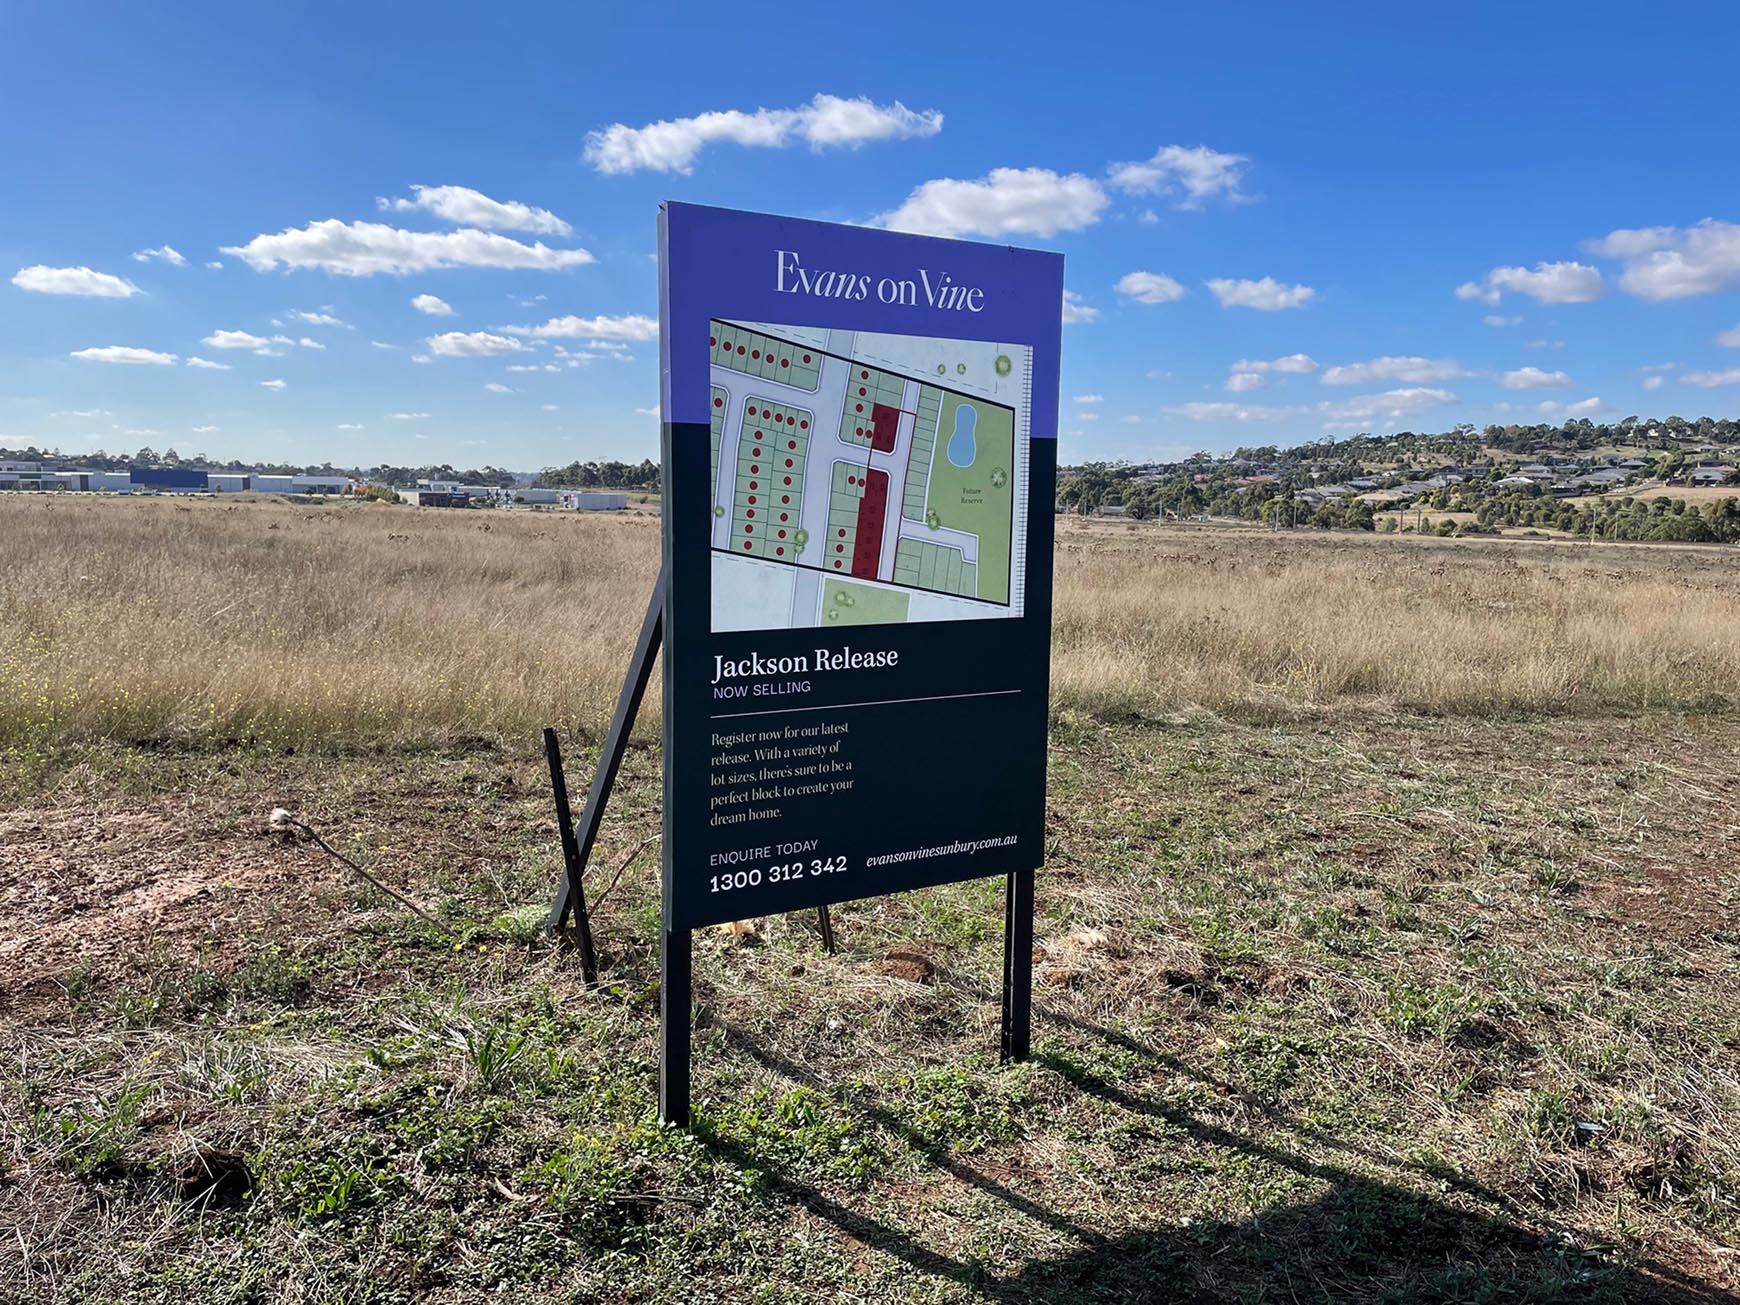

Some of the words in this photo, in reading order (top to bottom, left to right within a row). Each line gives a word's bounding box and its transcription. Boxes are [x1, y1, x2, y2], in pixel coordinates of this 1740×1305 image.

[774, 249, 871, 300] Evans
[877, 275, 918, 306] on
[916, 268, 985, 313] Vine
[960, 496, 983, 505] Reserve
[962, 487, 982, 495] Future
[711, 652, 808, 684] Jackson
[814, 646, 899, 672] Release
[713, 686, 748, 699] NOW
[753, 680, 811, 696] SELLING
[711, 732, 757, 748] Register
[759, 730, 782, 741] now
[784, 725, 799, 739] for
[801, 726, 820, 737] our
[821, 722, 849, 735] latest
[711, 752, 752, 766] release.
[754, 747, 782, 761] With
[783, 749, 790, 758] a
[792, 743, 828, 758] variety
[829, 739, 841, 753] of
[711, 773, 726, 786] lot
[794, 766, 817, 776] sure
[818, 763, 829, 773] to
[831, 760, 845, 772] be
[845, 761, 852, 770] a
[710, 790, 750, 810] perfect
[752, 785, 782, 801] block
[783, 786, 795, 797] to
[796, 781, 829, 795] create
[830, 779, 855, 795] your
[710, 811, 746, 826] dream
[749, 808, 782, 821] home.
[710, 846, 772, 867] ENQUIRE
[775, 839, 818, 856] TODAY
[866, 834, 1018, 868] evansonvinesunbury.com.au
[710, 869, 762, 893] 1300
[769, 862, 804, 883] 312
[810, 855, 848, 876] 342
